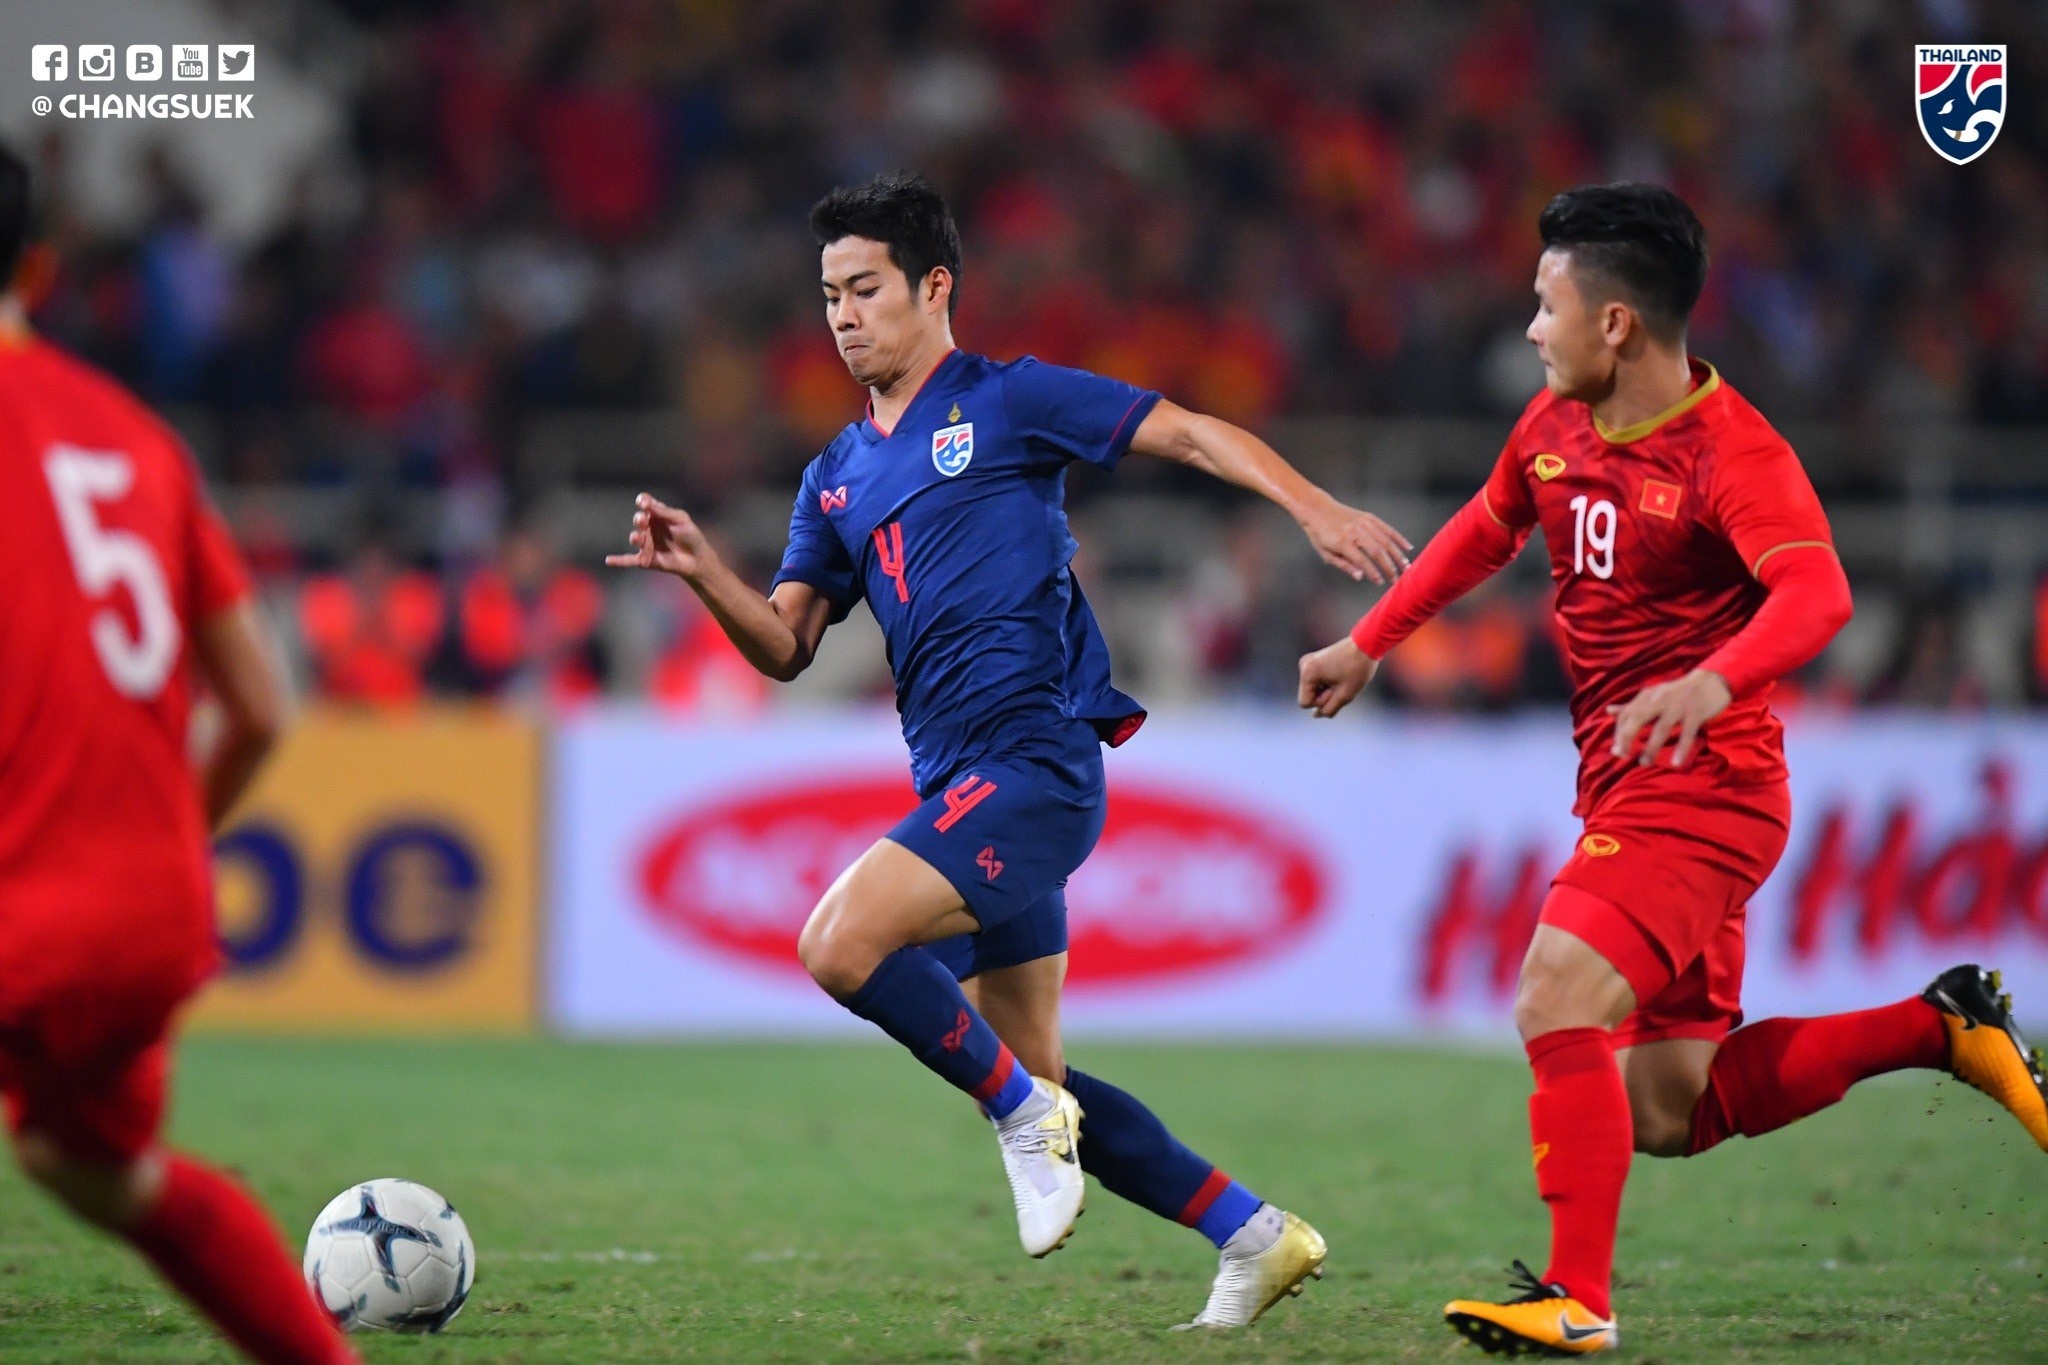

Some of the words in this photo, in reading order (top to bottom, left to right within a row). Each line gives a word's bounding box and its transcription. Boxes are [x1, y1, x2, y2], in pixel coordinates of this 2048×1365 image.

[42, 443, 183, 700] 5
[871, 521, 910, 604] 4
[1569, 494, 1618, 580] 19
[933, 775, 998, 834] 4
